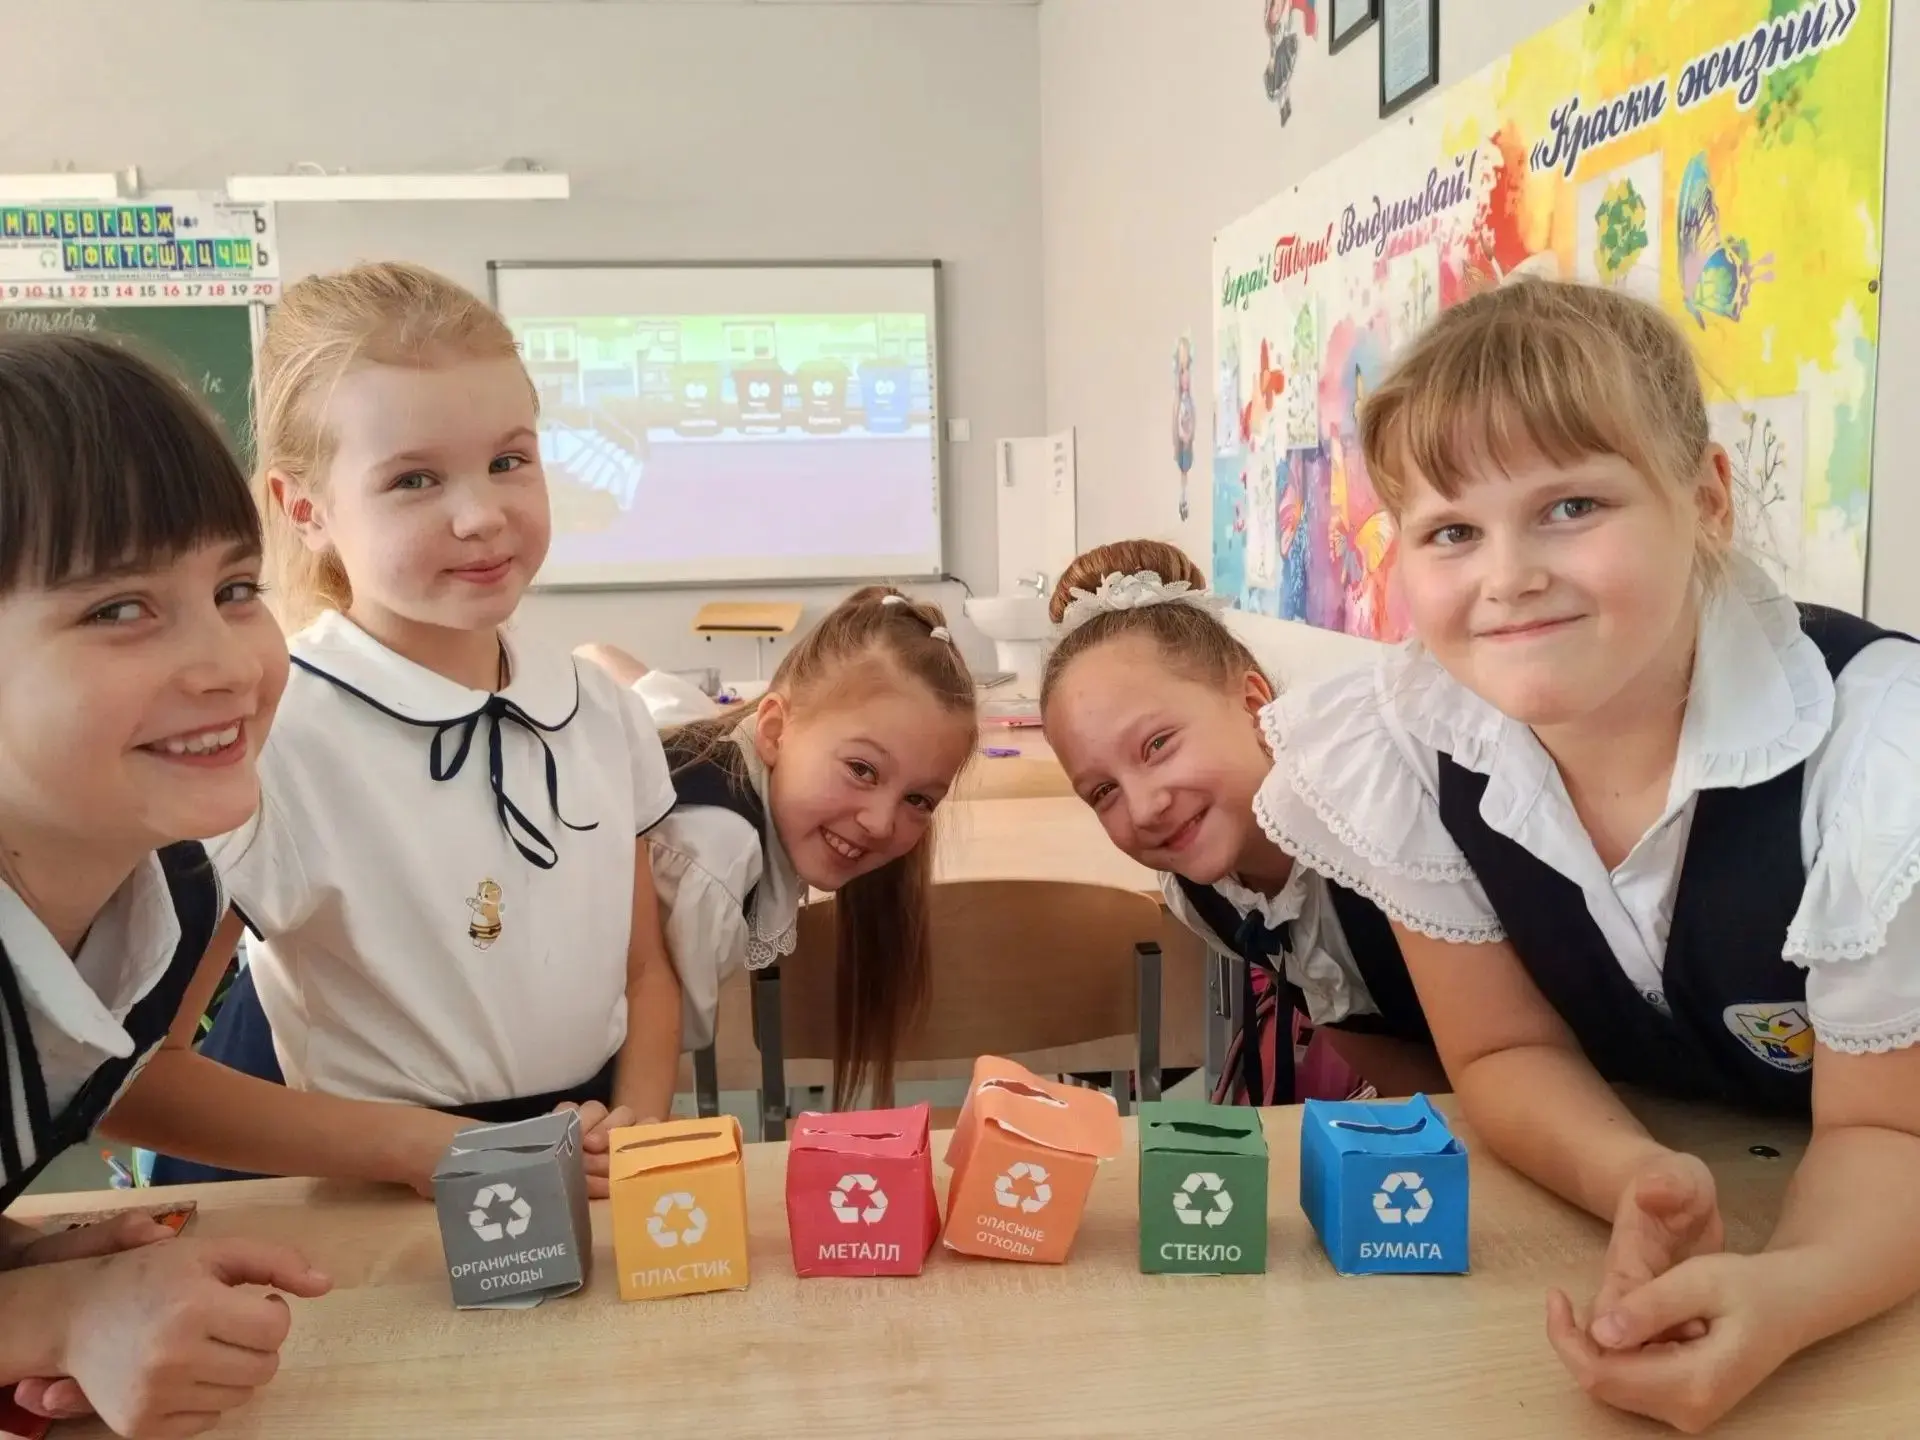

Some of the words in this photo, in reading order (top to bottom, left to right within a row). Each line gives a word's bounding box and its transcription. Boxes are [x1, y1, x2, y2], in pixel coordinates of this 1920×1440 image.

[1529, 96, 1667, 177] «Краски
[1677, 0, 1856, 105] жизни»
[1273, 222, 1334, 286] Твори!
[1337, 149, 1477, 257] Выдумывай!
[8, 286, 19, 298] 9
[25, 286, 43, 298] 10
[48, 286, 64, 298] 11
[70, 285, 88, 298] 12
[93, 285, 110, 297] 13
[115, 285, 134, 297] 14
[140, 285, 157, 297] 15
[163, 285, 181, 297] 16
[186, 285, 202, 296] 17
[208, 284, 226, 297] 18
[231, 284, 248, 296] 19
[254, 284, 273, 296] 20
[976, 1214, 1045, 1243] ОПАСНЫЕ
[817, 1242, 901, 1262] МЕТАЛЛ
[976, 1231, 1034, 1257] ОТХОДЫ
[1160, 1242, 1242, 1262] СТЕКЛО
[1359, 1241, 1443, 1261] БУМАГА
[451, 1242, 567, 1279] ОРГАНИЧЕСКИЕ
[631, 1259, 732, 1288] ПЛАСТИК
[479, 1267, 543, 1291] ОТХОДЫ
